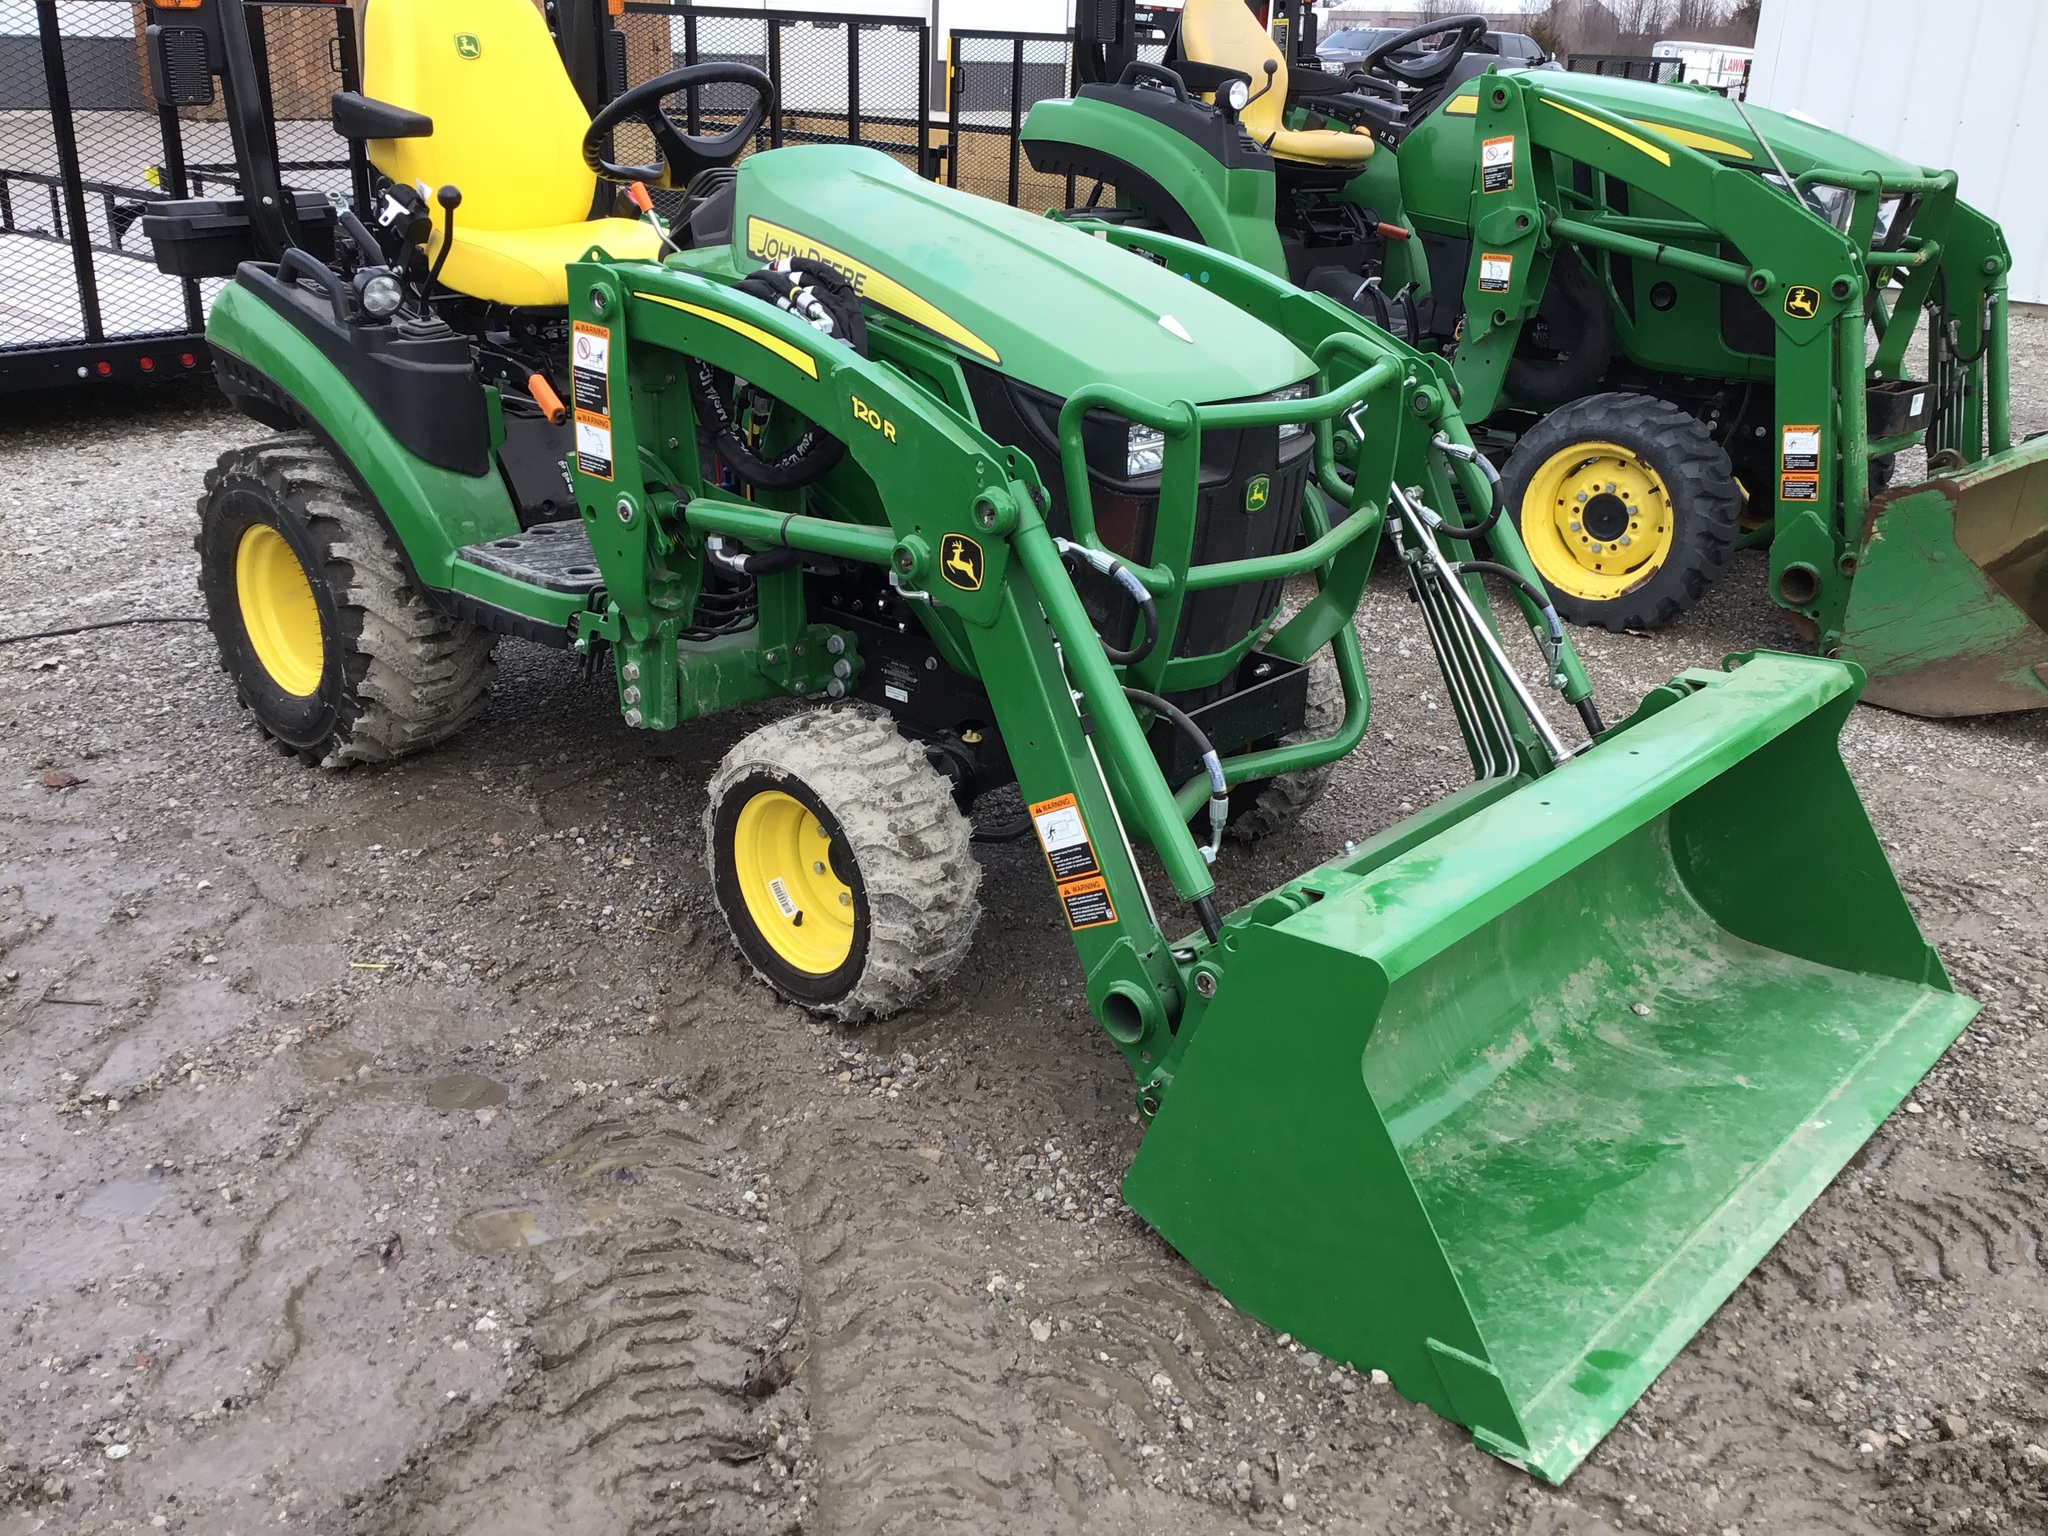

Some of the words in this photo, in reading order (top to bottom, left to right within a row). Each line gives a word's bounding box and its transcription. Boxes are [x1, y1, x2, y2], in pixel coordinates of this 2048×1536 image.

[580, 323, 608, 338] WARNING
[582, 414, 609, 429] WARNING
[1042, 798, 1070, 811] WARNING
[1071, 880, 1100, 893] WARNING
